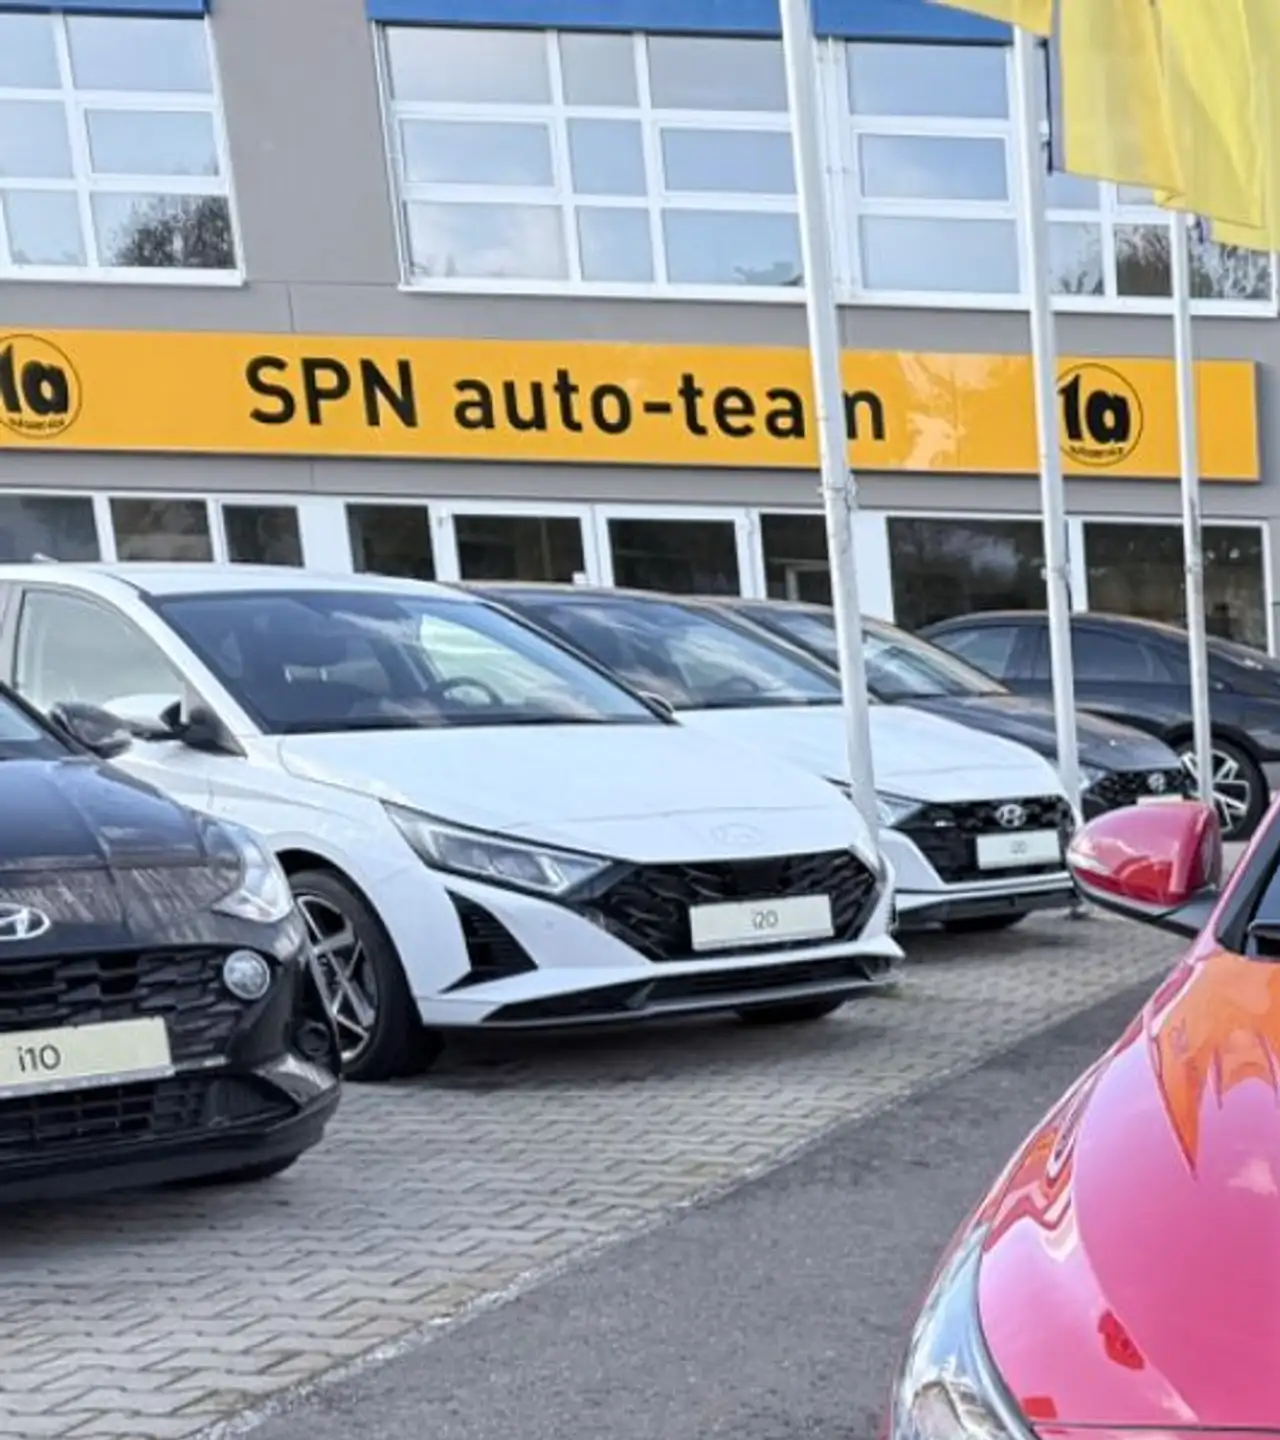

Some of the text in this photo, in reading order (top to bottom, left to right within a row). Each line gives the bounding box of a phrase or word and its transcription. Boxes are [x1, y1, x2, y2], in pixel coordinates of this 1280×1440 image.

[245, 355, 886, 441] SPN auto-team
[1057, 373, 1131, 445] 1a
[17, 1043, 62, 1074] i10
